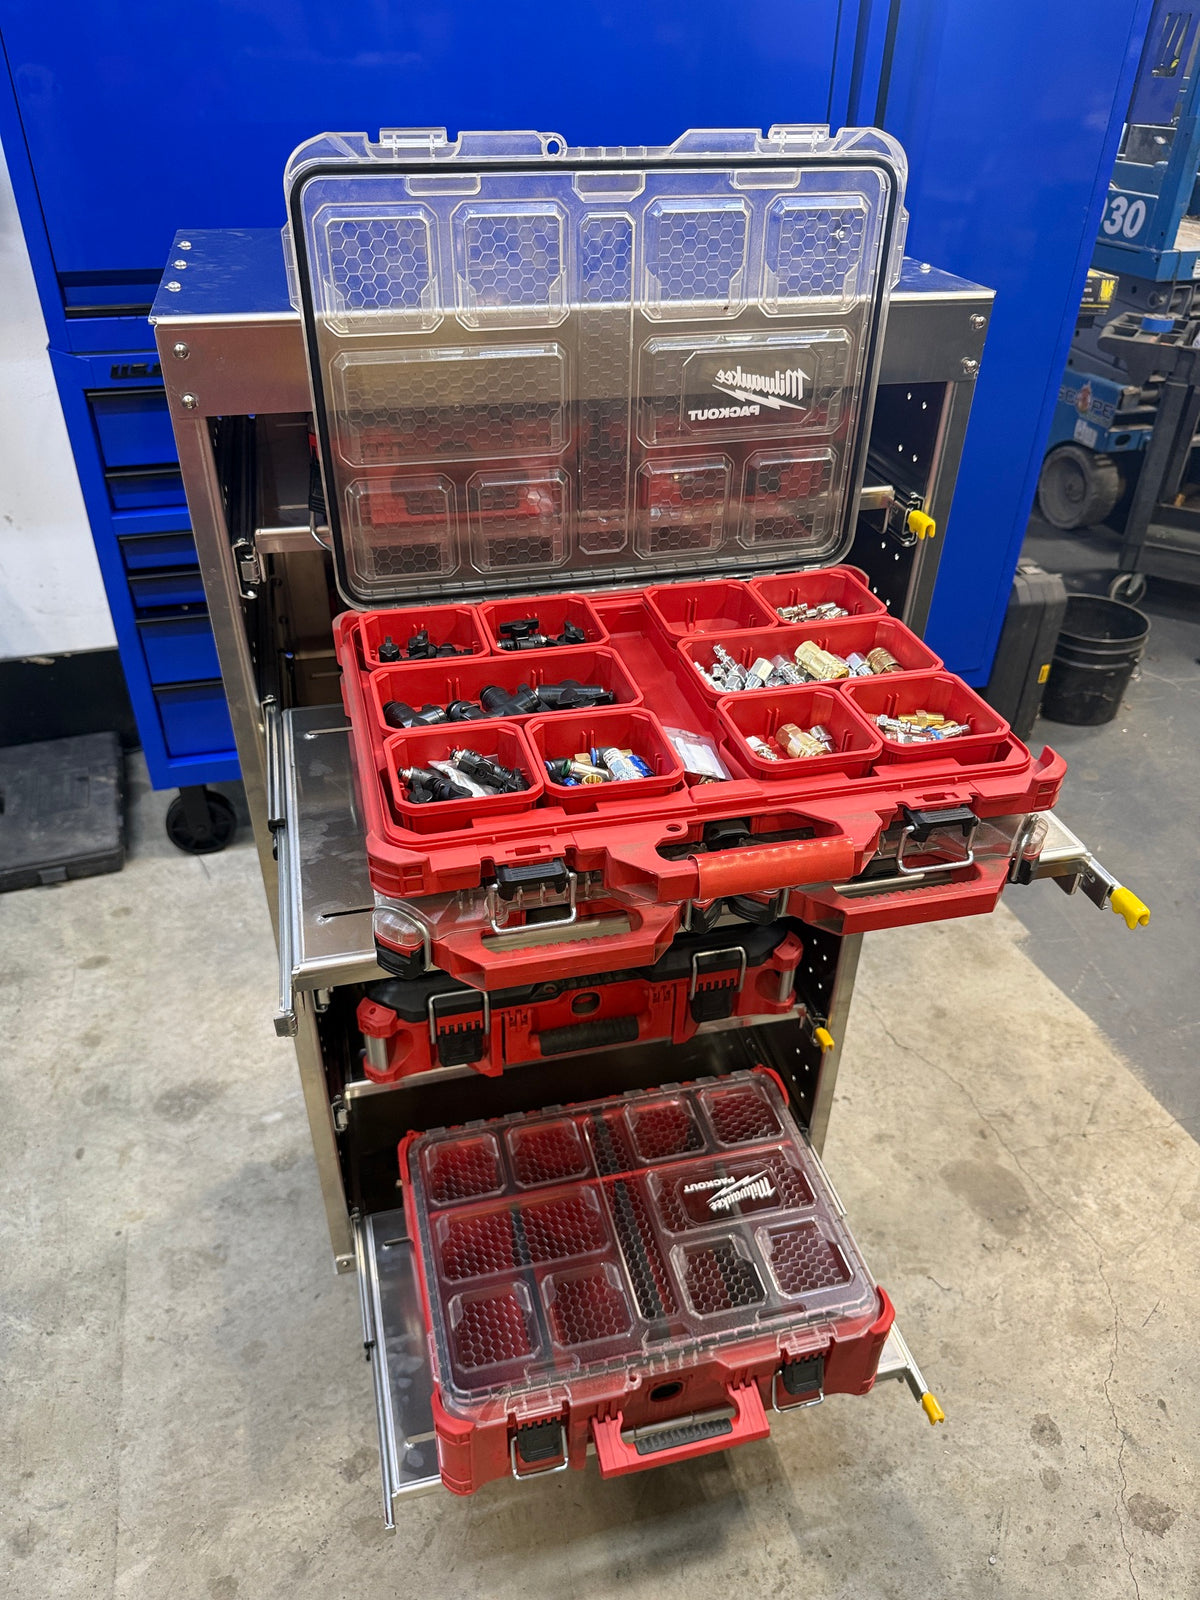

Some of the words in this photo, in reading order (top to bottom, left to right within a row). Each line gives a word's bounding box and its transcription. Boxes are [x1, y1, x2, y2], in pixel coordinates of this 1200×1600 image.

[1101, 196, 1146, 238] 30
[684, 1176, 736, 1193] PACKOUT
[709, 1176, 776, 1213] Milwaukee
